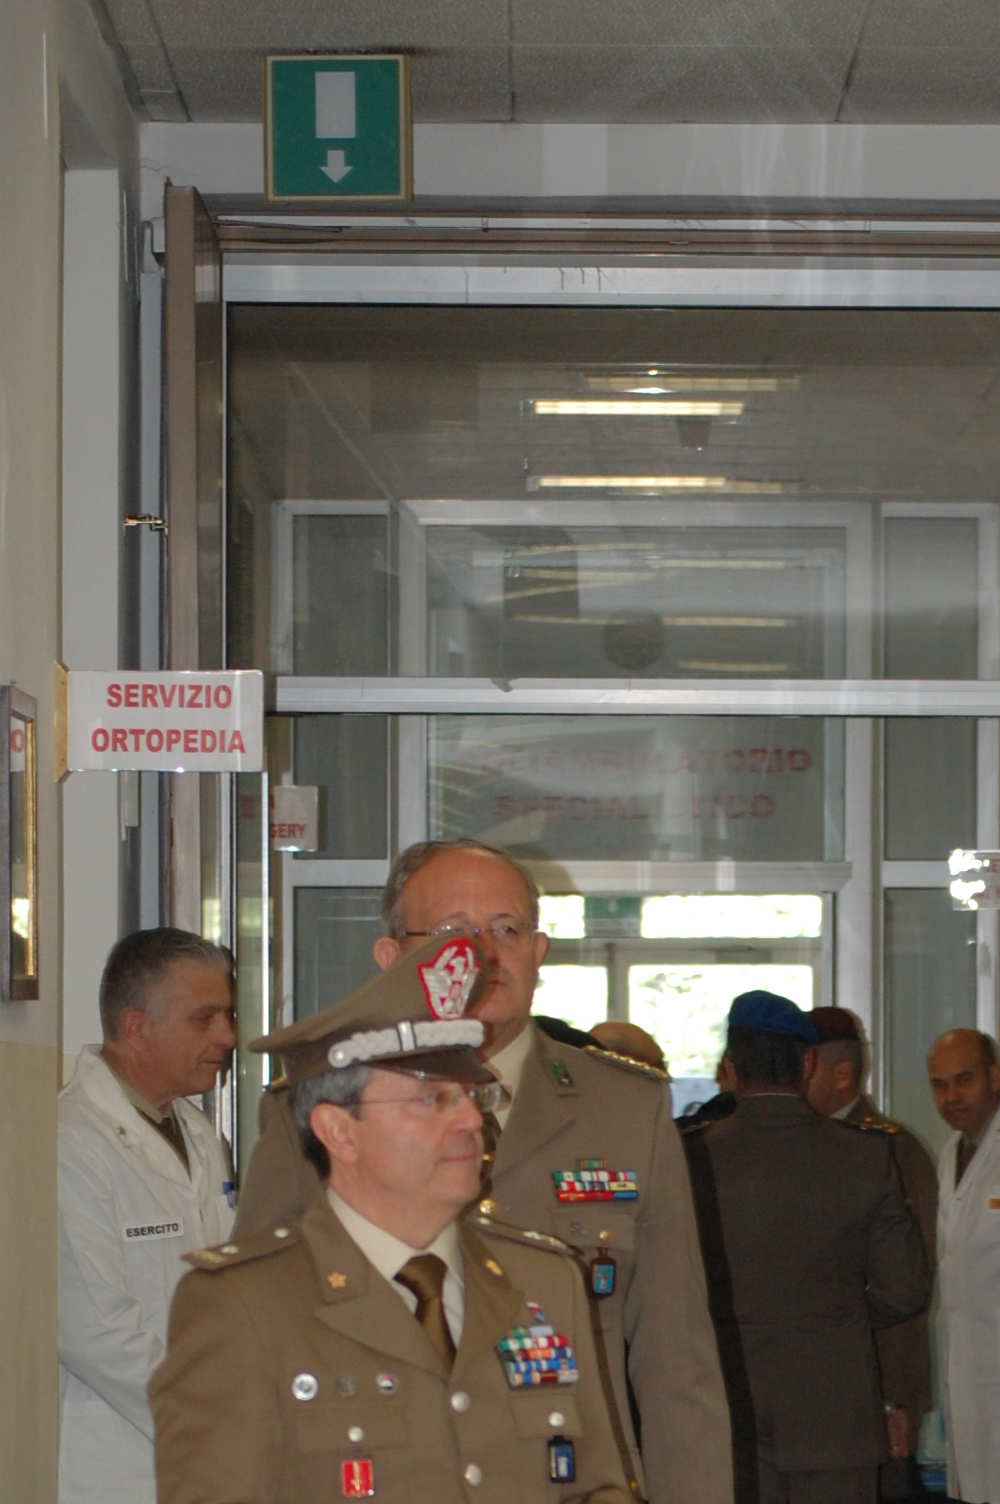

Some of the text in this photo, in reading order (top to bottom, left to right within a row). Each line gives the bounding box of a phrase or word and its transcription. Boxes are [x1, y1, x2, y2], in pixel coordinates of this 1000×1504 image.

[106, 683, 232, 709] SERVIZIO
[91, 728, 246, 753] ORTOPEDIA
[126, 1222, 179, 1237] ESERCITO
